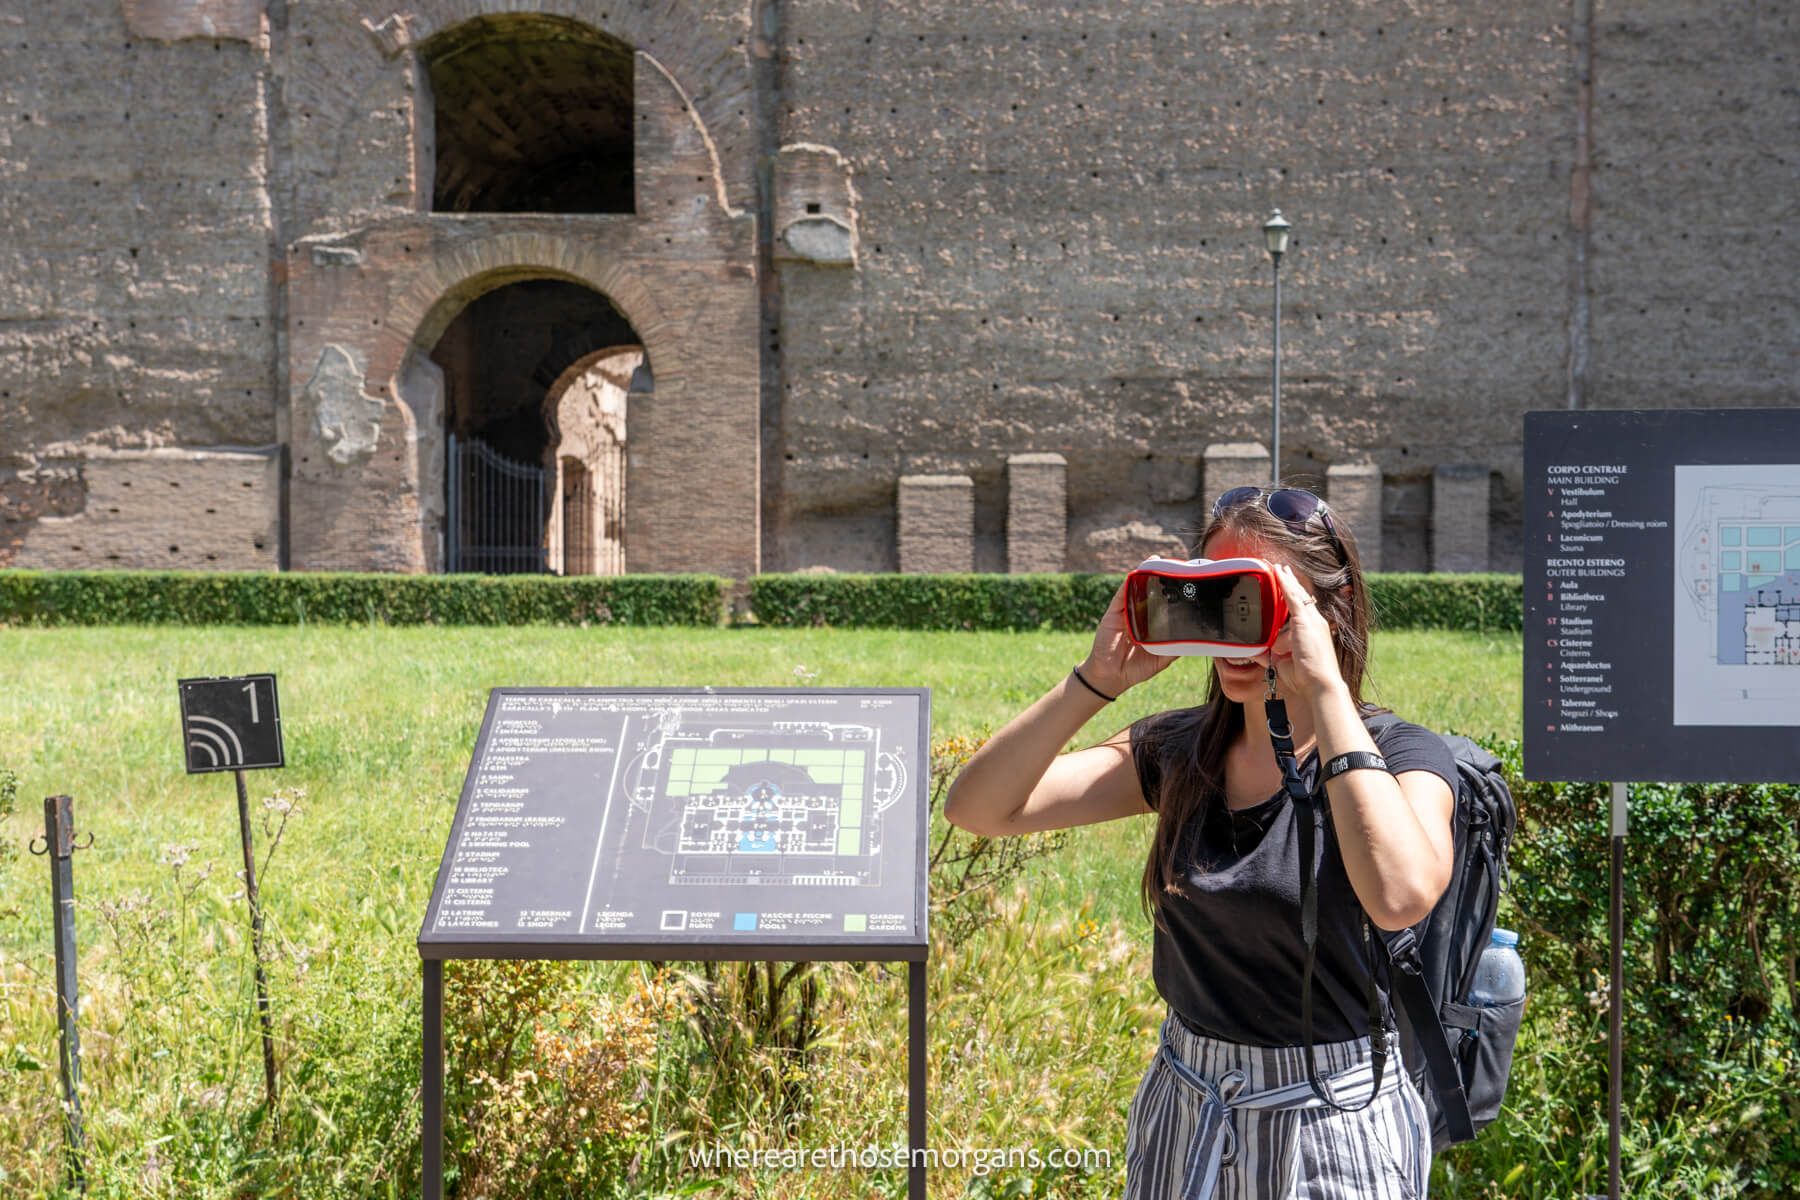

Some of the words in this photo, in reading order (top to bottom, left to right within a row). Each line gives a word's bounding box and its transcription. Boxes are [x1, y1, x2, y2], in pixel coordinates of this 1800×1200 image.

[1547, 465, 1580, 474] CORPO
[1582, 465, 1628, 474] CENTRALE
[1547, 476, 1572, 484] MAIN
[1574, 476, 1619, 484] BUILDING
[1561, 487, 1605, 496] Vestibulum
[1561, 498, 1578, 506] Hall
[1561, 509, 1612, 520] Apodyterium
[1561, 520, 1605, 530] Spogliatoio
[1611, 520, 1645, 530] Dressing
[1560, 533, 1604, 542] Laconicum
[1560, 544, 1584, 553] Sauna
[1546, 558, 1585, 567] RECINTO
[1586, 558, 1626, 567] ESTERNO
[1546, 568, 1577, 577] OUTER
[1578, 568, 1626, 577] BUILDINGS
[1560, 580, 1579, 589] Aula
[1560, 592, 1605, 601] Bibliotheca
[1560, 603, 1588, 613] Library
[1547, 617, 1558, 625] ST
[1560, 617, 1593, 626] Stadium
[1560, 626, 1593, 635] Stadium
[1560, 639, 1593, 647] Cisterne
[1560, 649, 1591, 657] Cisterns
[1560, 674, 1604, 683] Sotterranei
[1560, 684, 1612, 694] Underground
[242, 681, 259, 724] 1
[1561, 698, 1596, 707] Tabernae
[1560, 723, 1604, 732] Mithraeum
